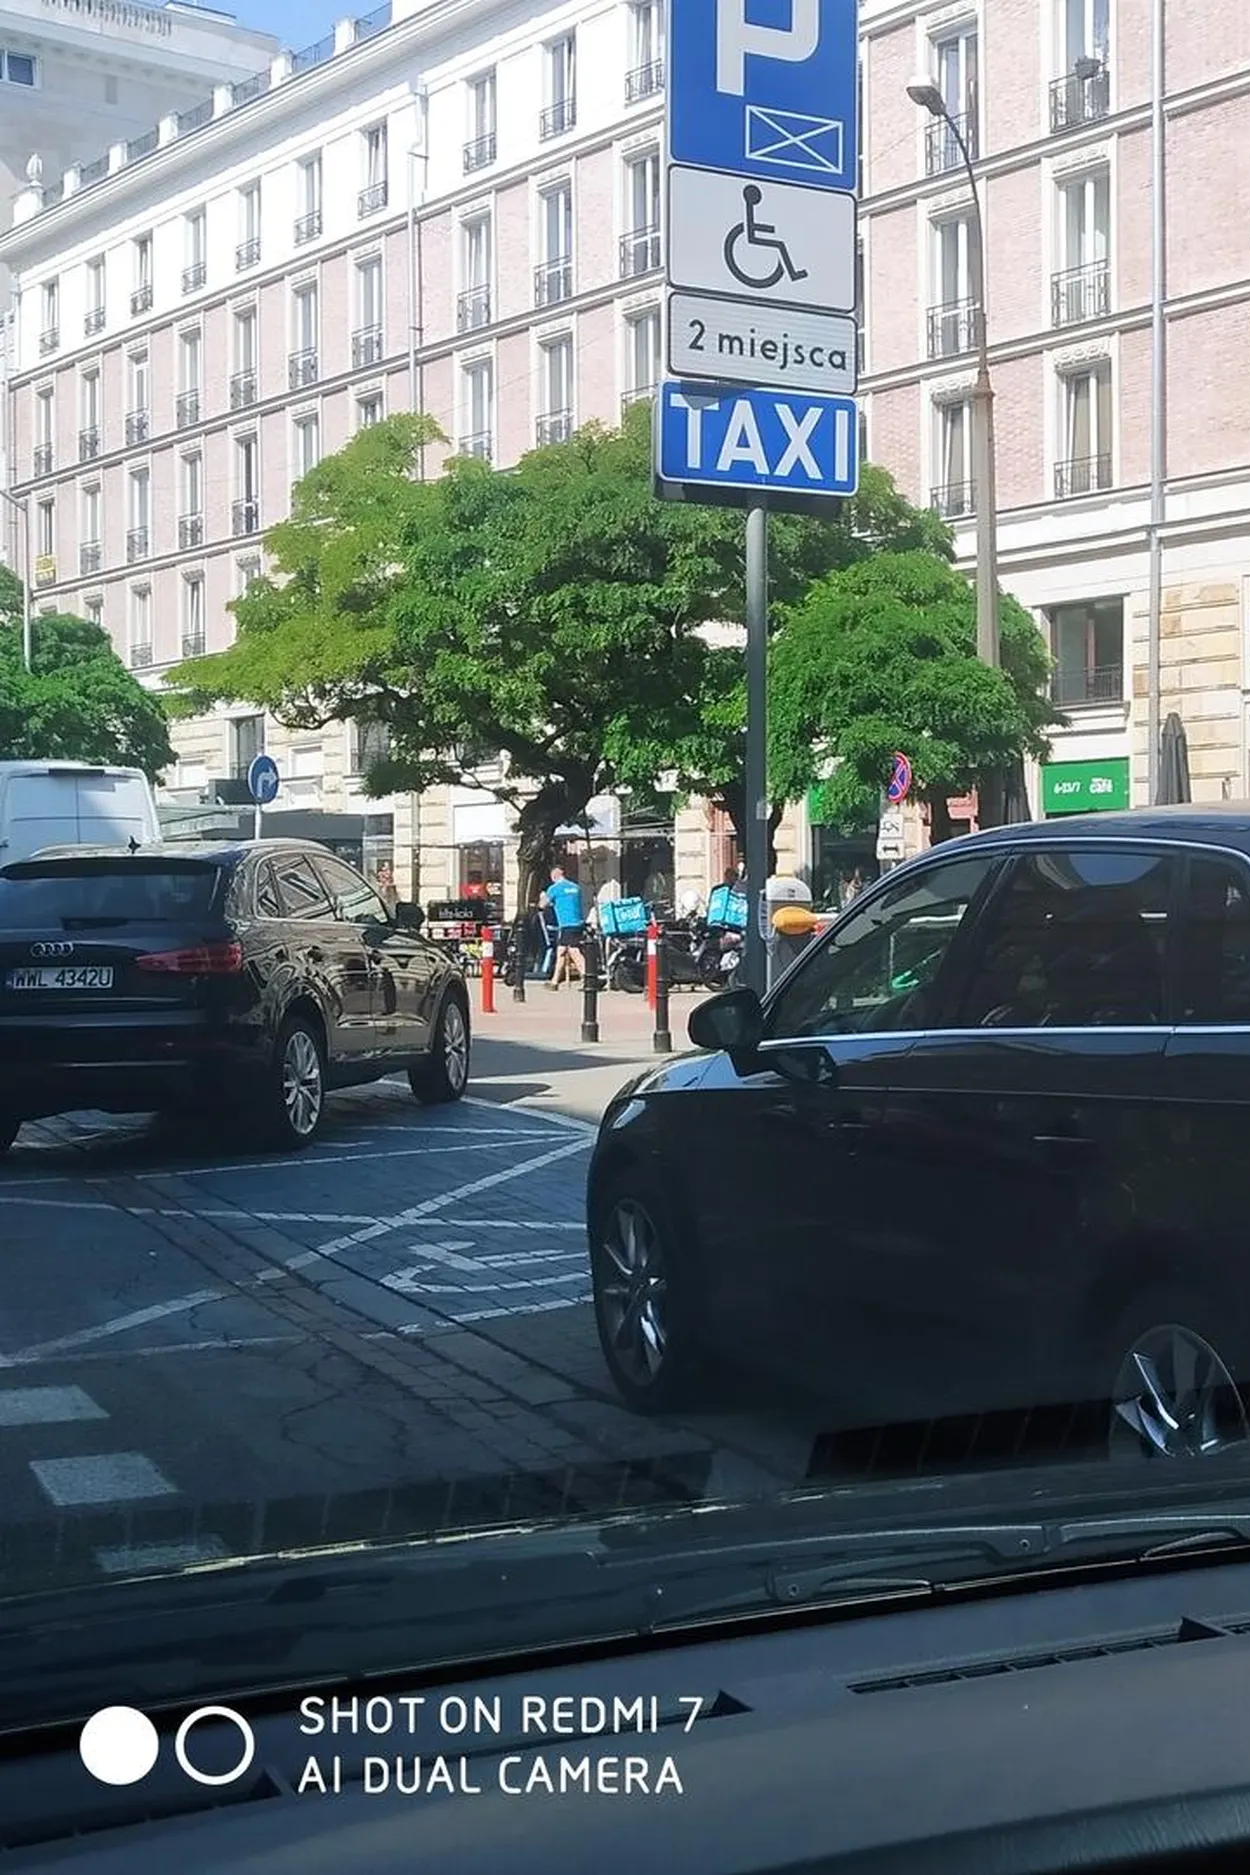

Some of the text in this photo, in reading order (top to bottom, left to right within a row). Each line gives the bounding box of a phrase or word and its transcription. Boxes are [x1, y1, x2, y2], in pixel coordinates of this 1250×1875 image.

[716, 0, 820, 96] P
[688, 319, 847, 371] 2 miejsca
[669, 393, 849, 483] TAXI
[55, 968, 112, 987] 4342U
